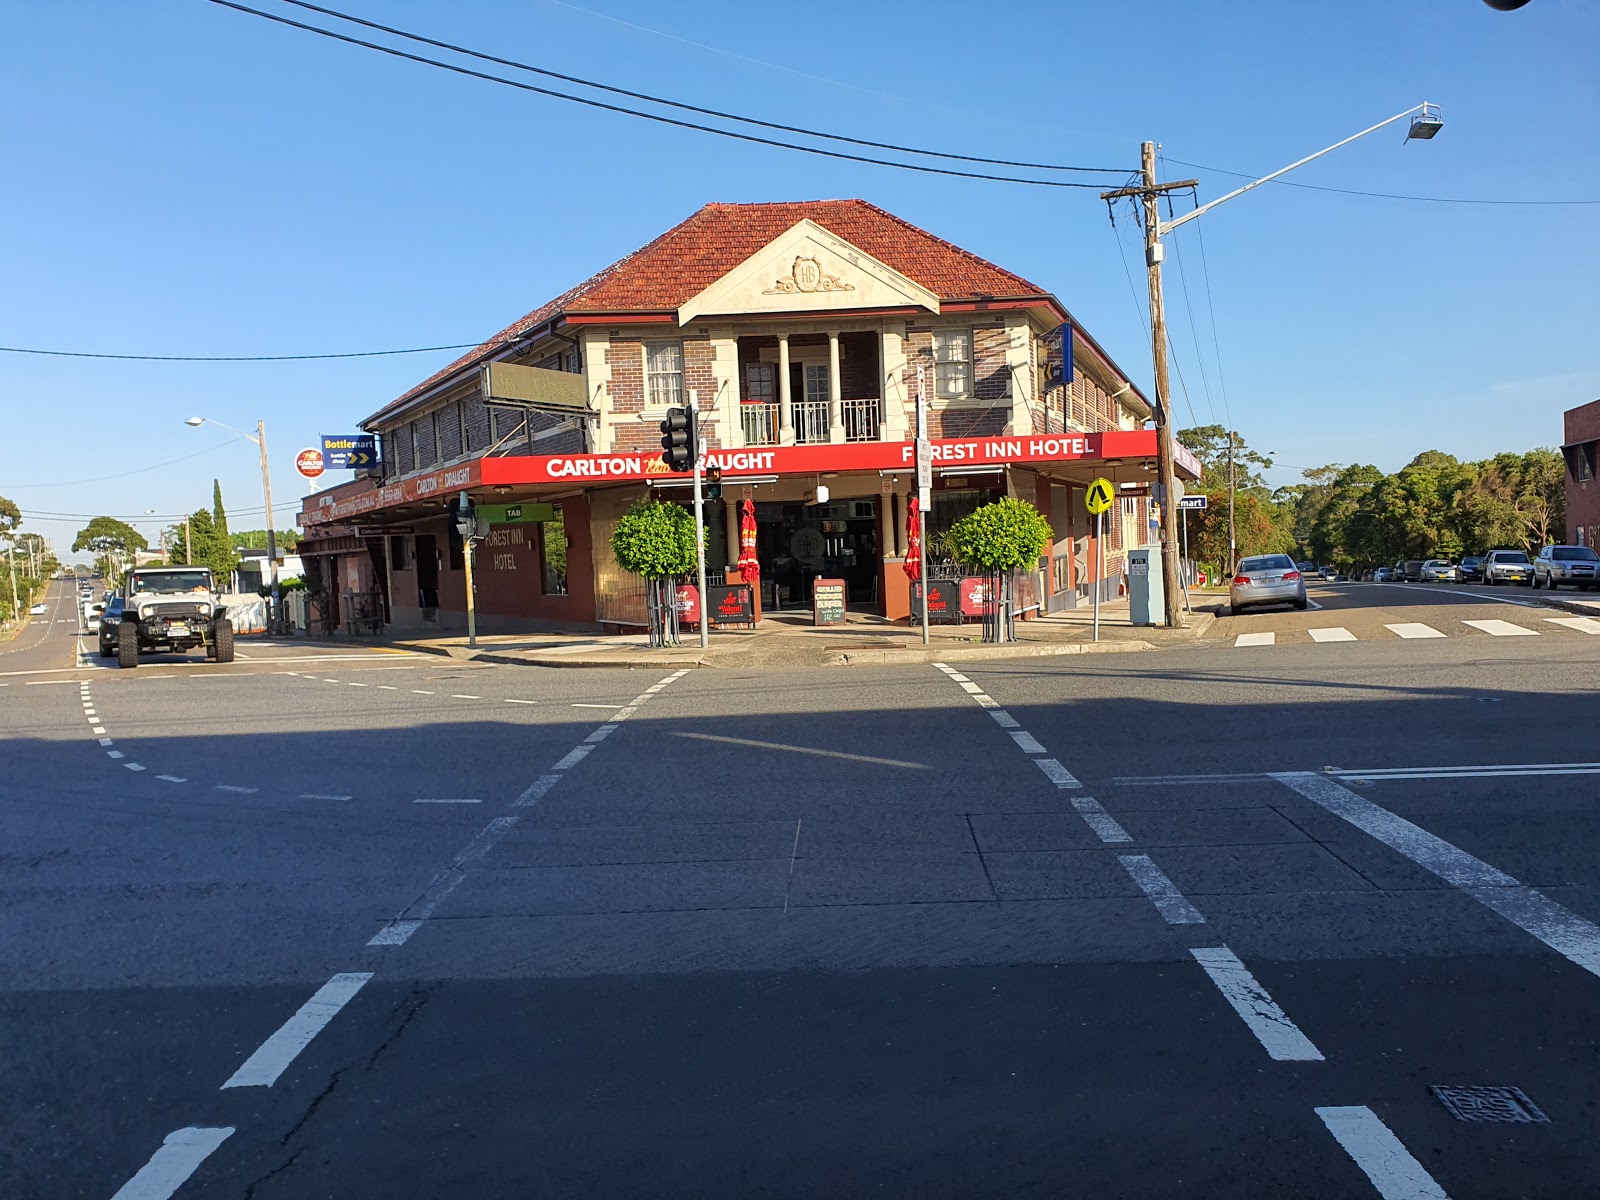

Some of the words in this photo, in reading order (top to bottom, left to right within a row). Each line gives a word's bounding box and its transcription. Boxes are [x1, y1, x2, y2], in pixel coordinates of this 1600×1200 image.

[325, 439, 373, 449] Bottlemart
[902, 443, 978, 461] FREST
[985, 441, 1022, 458] INN
[1030, 438, 1094, 456] HOTEL
[546, 457, 641, 477] CARLTON
[698, 452, 775, 472] RAUGHT
[417, 477, 438, 495] CARLTON
[444, 467, 470, 487] DRAUGHT
[506, 509, 521, 517] TAB
[511, 528, 524, 544] INN
[494, 553, 516, 570] HOTEL
[1452, 1097, 1514, 1110] GAS
